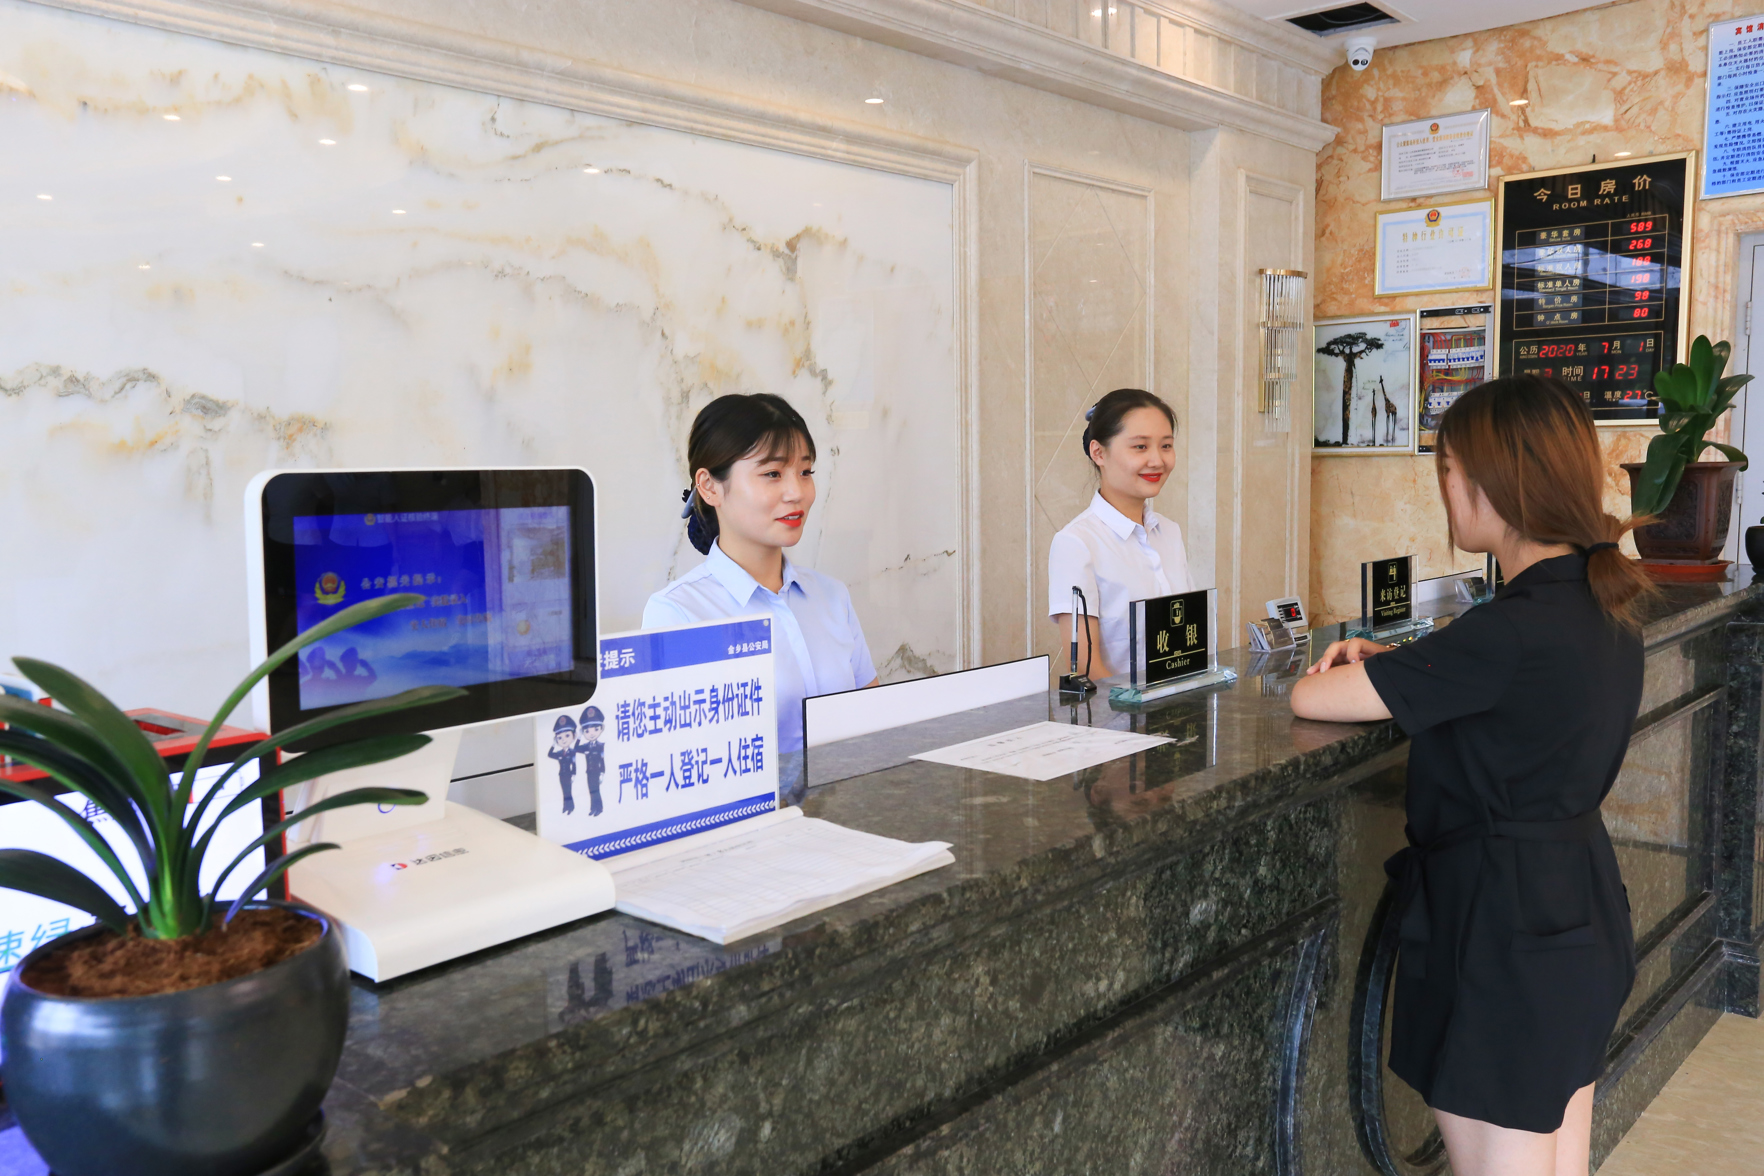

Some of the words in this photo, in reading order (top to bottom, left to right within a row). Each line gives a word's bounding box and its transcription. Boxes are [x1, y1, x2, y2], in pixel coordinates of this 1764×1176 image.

[1534, 174, 1652, 202] 今日房价
[1552, 200, 1587, 210] ROOM
[1594, 194, 1630, 206] RATE
[1630, 221, 1652, 232] 589
[1540, 228, 1581, 240] 豪华套房
[1628, 238, 1652, 250] 268
[1631, 256, 1651, 266] 188
[1538, 278, 1580, 289] 标准单人房
[1630, 273, 1650, 284] 198
[1538, 295, 1578, 306] 特价房
[1634, 290, 1650, 301] 98
[1538, 312, 1578, 322] 钟点房
[1633, 308, 1649, 318] 80
[1520, 345, 1538, 354] 公历
[1539, 344, 1576, 358] 2020
[1578, 343, 1586, 352] 年
[1602, 342, 1609, 354] 7
[1612, 340, 1621, 350] 月
[1638, 342, 1644, 352] 1
[1646, 338, 1654, 348] 日
[1562, 366, 1584, 376] 时间
[1592, 366, 1609, 380] 17
[1616, 364, 1638, 380] 23
[1604, 390, 1622, 398] 温度
[1624, 390, 1642, 400] 27
[1380, 585, 1406, 602] 来访登记
[1156, 624, 1198, 653] 收银
[728, 640, 769, 655] 金乡县公安局
[1166, 658, 1190, 670] Cashier
[616, 678, 763, 742] 请您主动出示身份证件
[618, 734, 764, 804] 严格一人登记一人住宿
